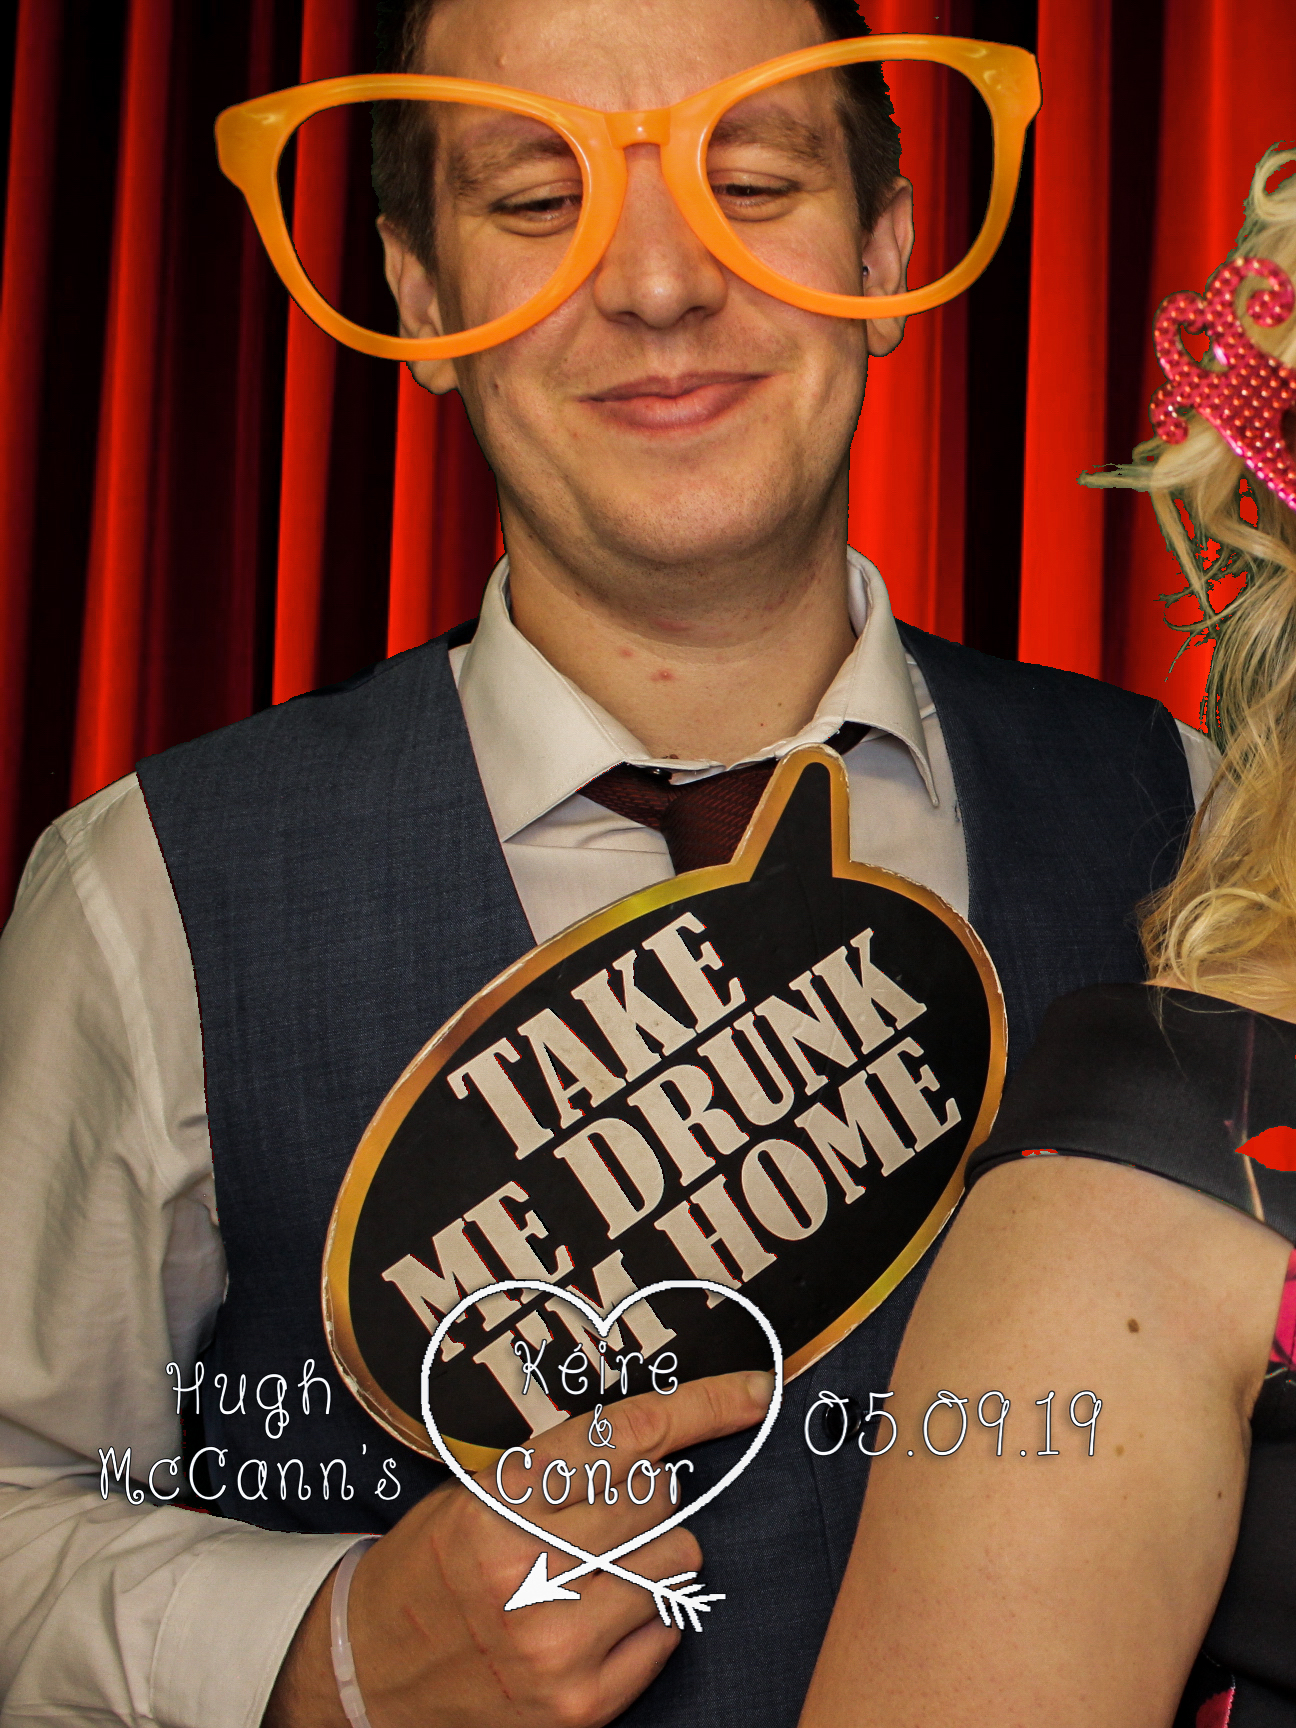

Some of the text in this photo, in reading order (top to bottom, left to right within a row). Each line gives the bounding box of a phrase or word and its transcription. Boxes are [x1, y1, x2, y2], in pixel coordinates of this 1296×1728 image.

[381, 928, 928, 1362] ME DRUNK
[447, 912, 746, 1160] TAKE
[654, 1036, 963, 1308] HOME
